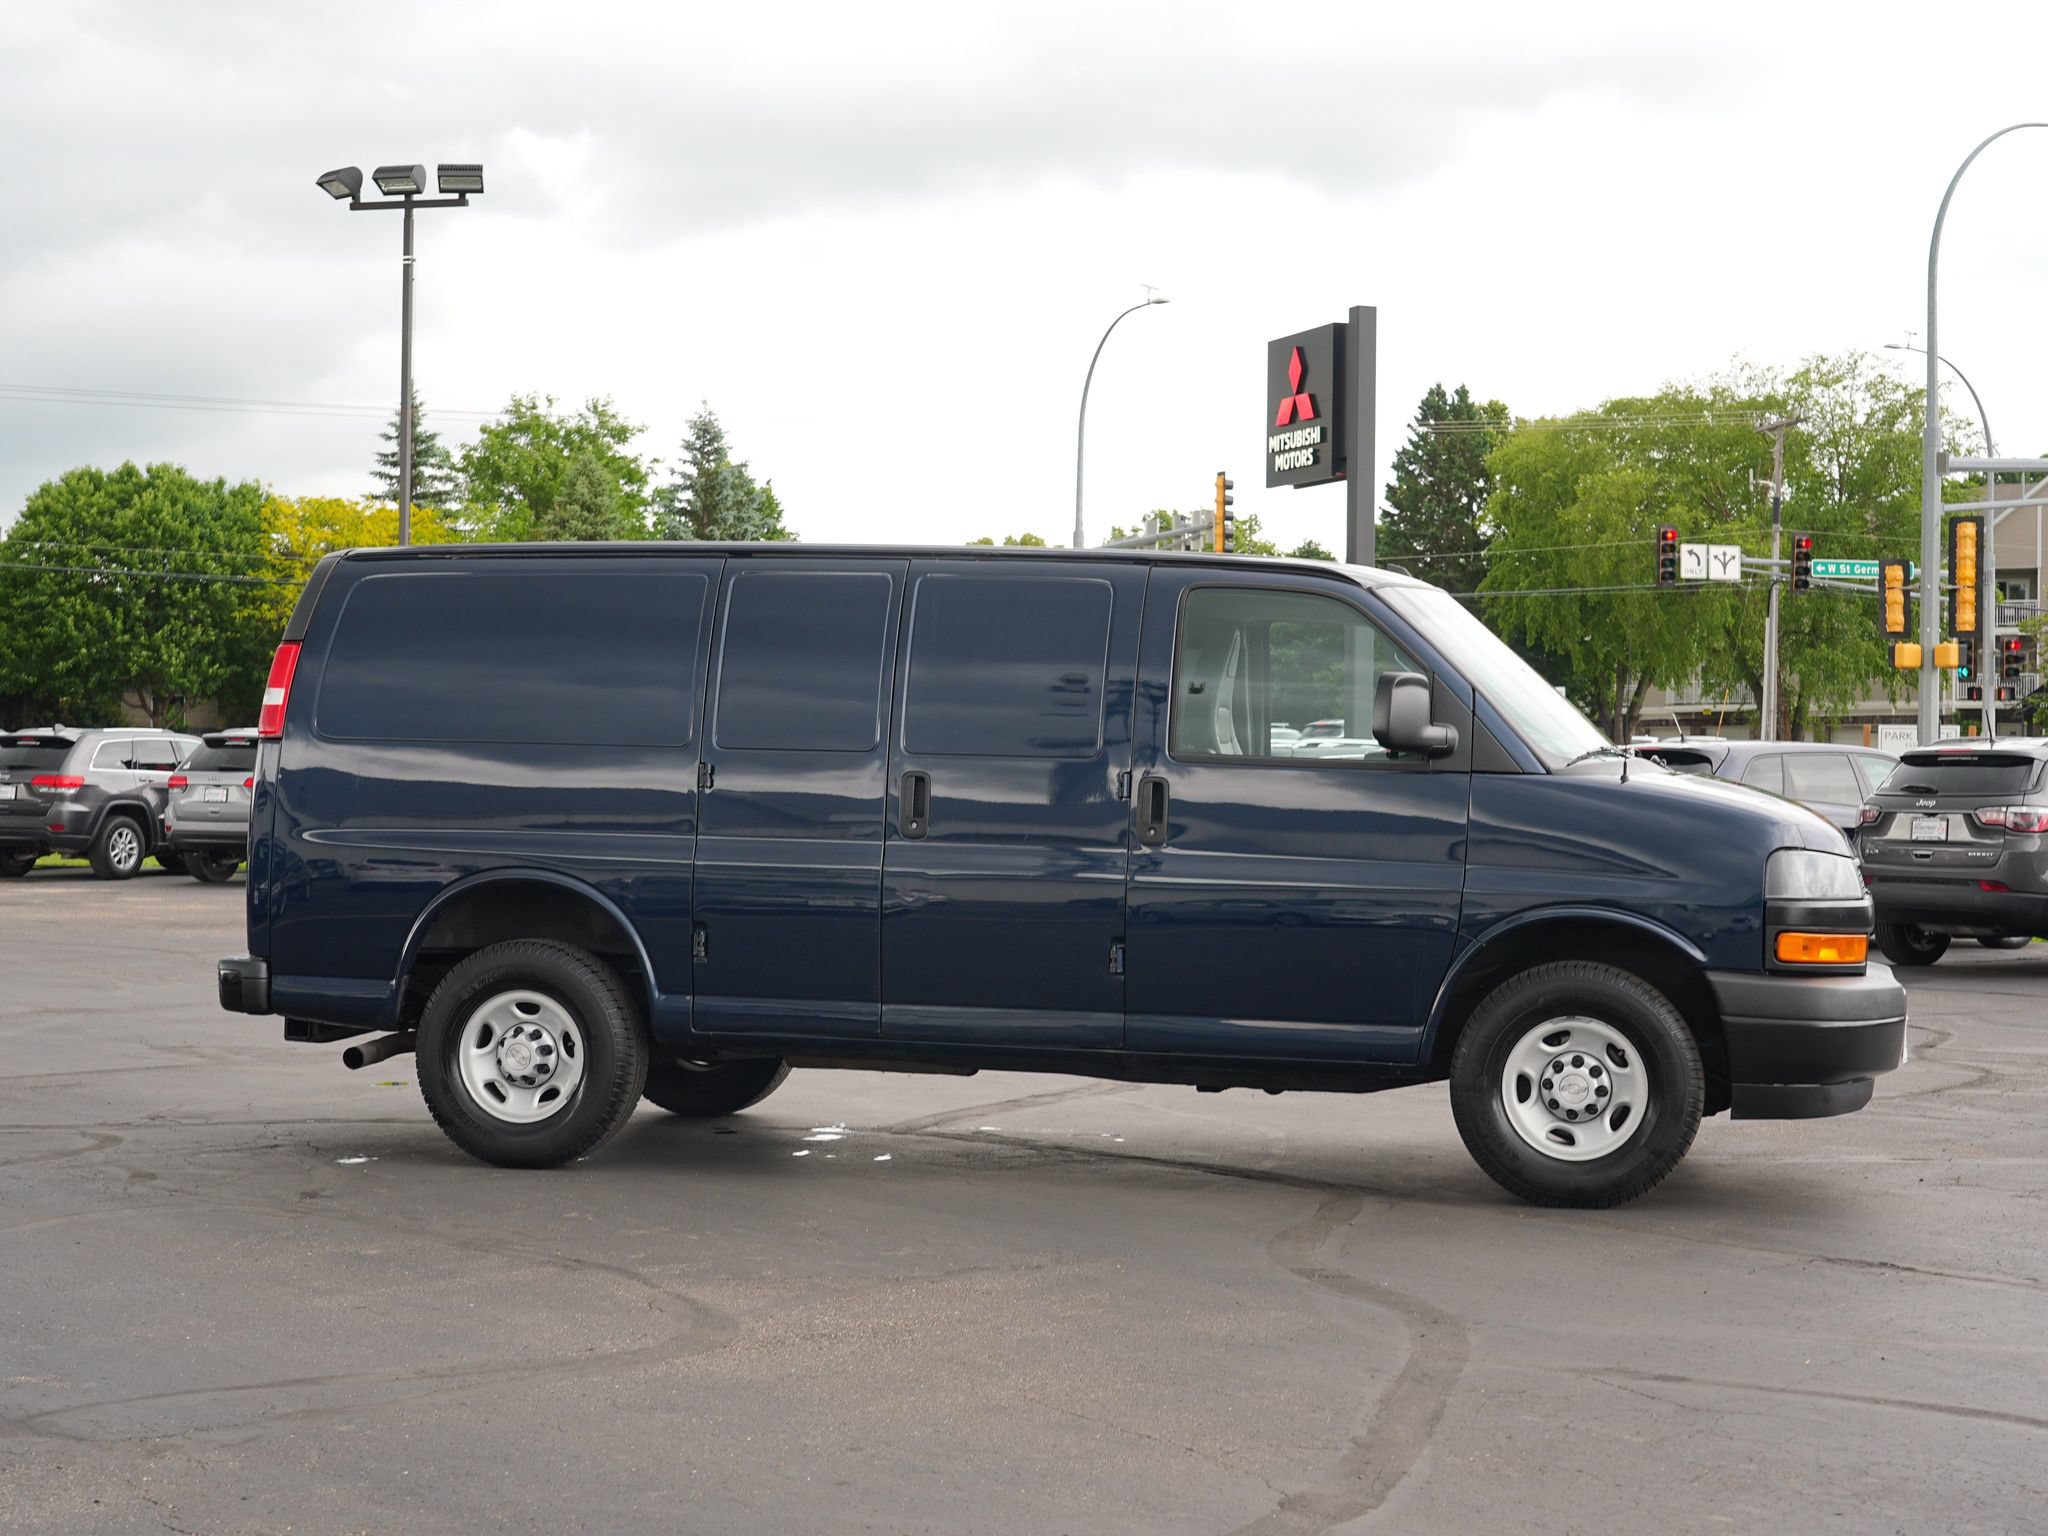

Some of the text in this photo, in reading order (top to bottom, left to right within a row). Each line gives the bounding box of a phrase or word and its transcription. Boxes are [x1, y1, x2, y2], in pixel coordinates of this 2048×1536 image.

[1269, 426, 1320, 453] MITSUBISHI
[1275, 448, 1313, 472] MOTORS
[1828, 564, 1879, 574] W St Germ
[1885, 731, 1913, 741] PARK
